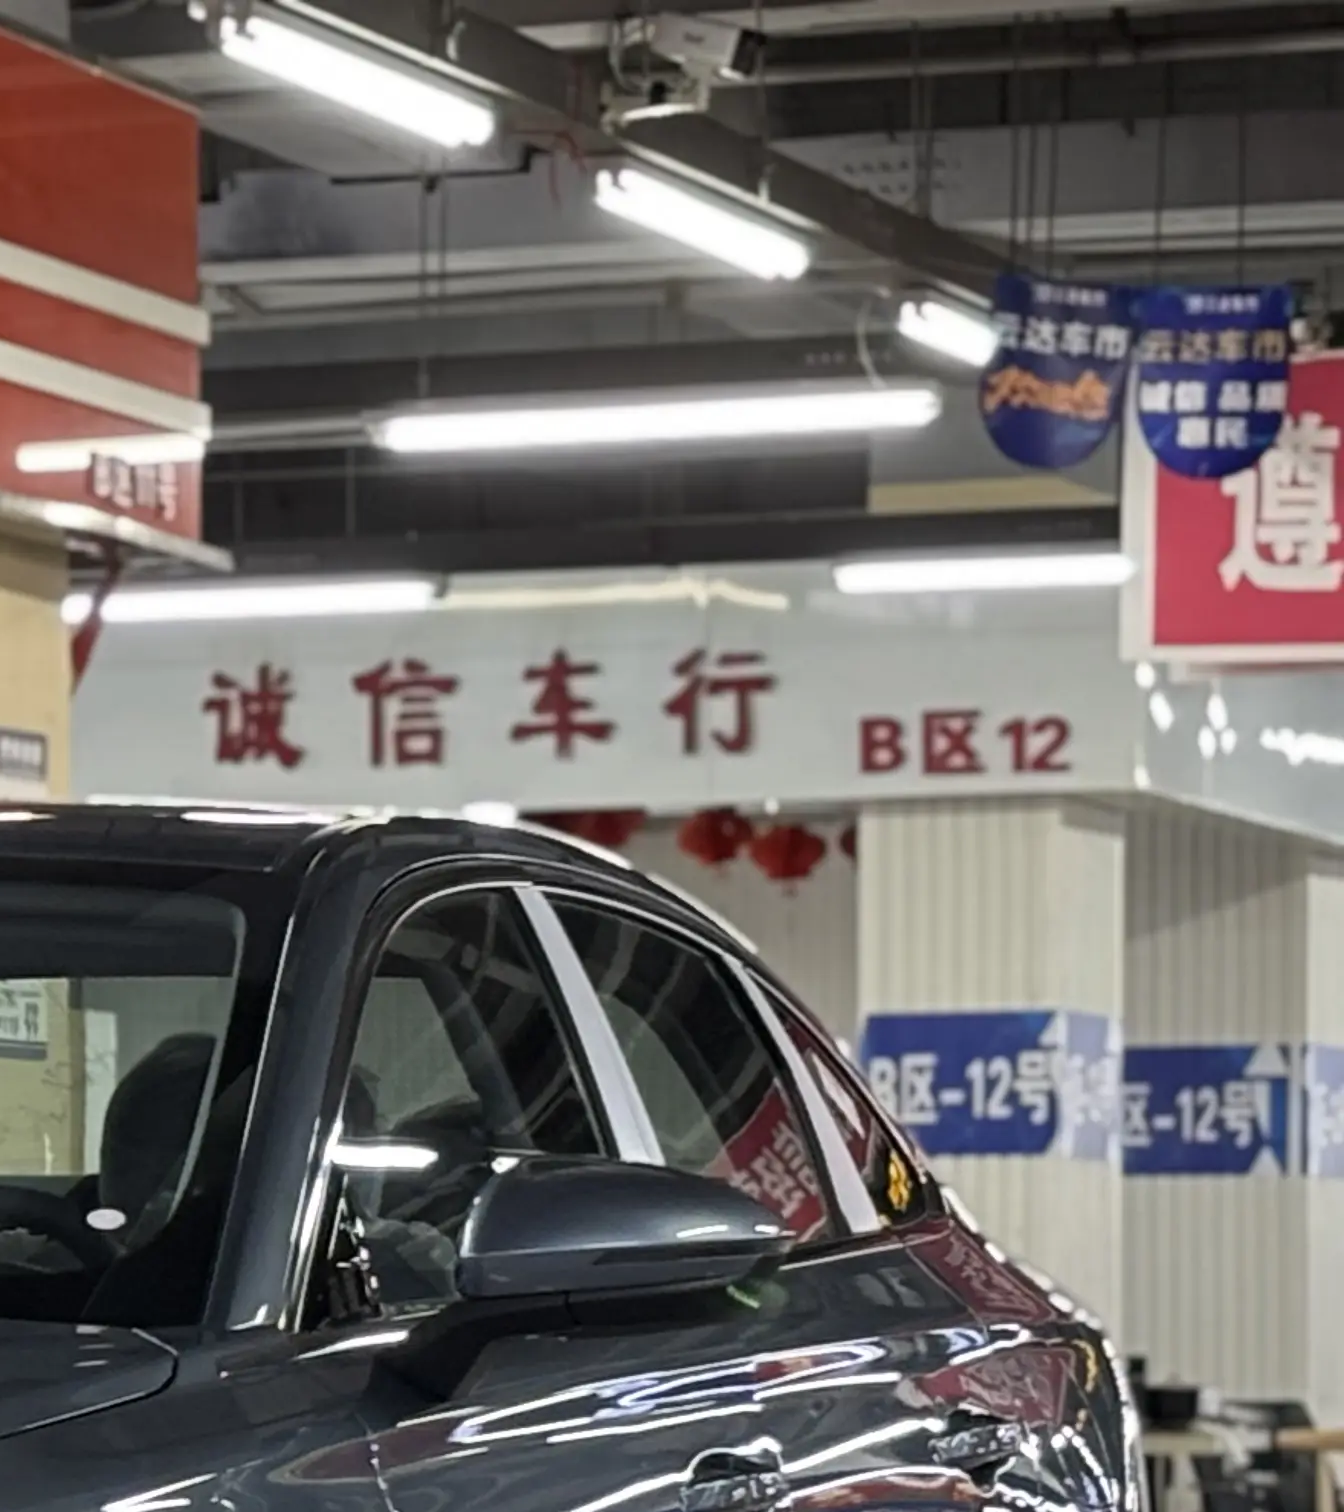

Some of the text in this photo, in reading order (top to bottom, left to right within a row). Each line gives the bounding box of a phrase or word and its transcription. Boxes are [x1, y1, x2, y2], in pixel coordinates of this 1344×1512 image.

[202, 648, 777, 769] 诚信车行
[869, 1052, 1053, 1126] B区-12号
